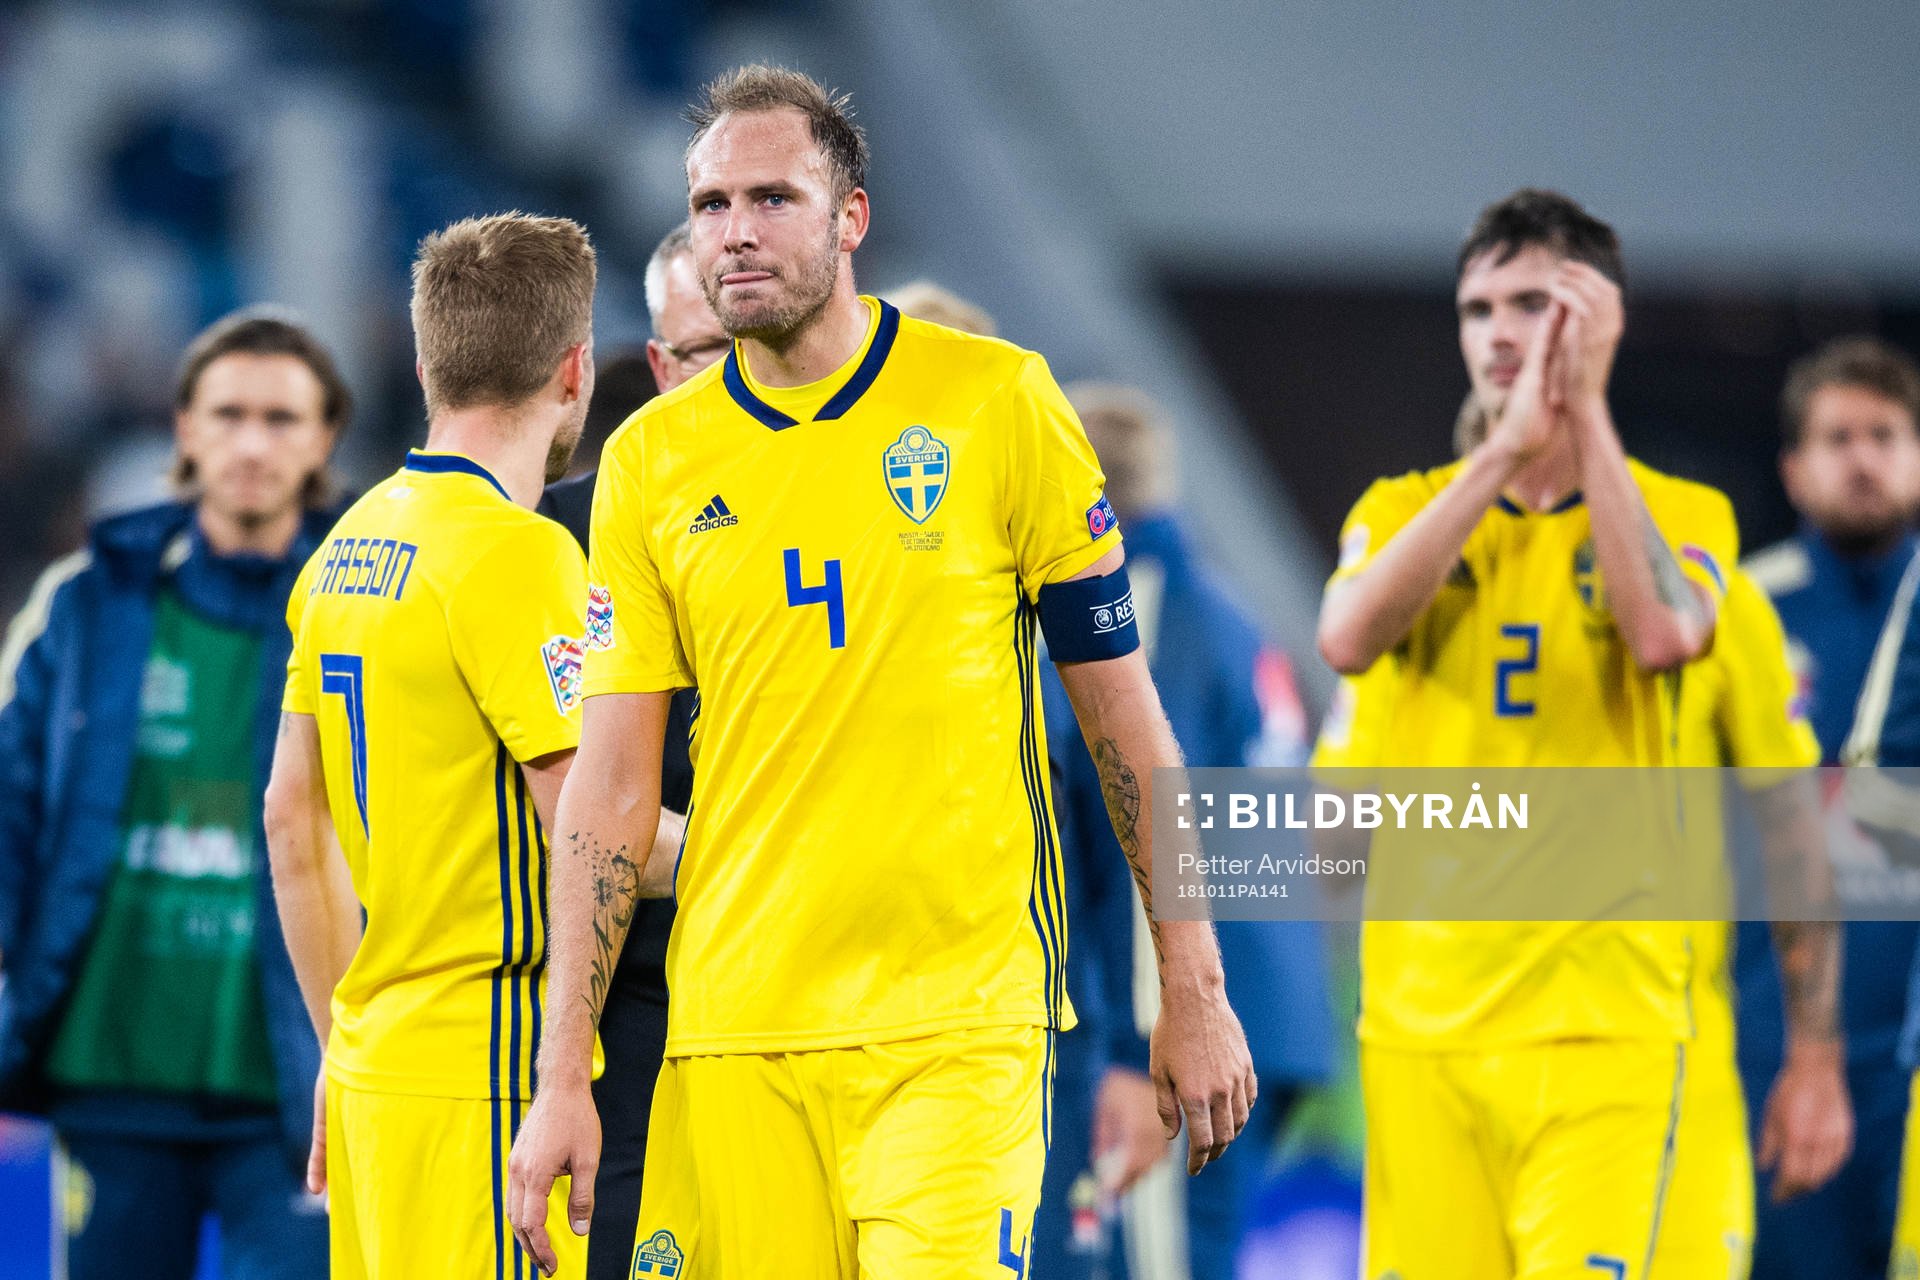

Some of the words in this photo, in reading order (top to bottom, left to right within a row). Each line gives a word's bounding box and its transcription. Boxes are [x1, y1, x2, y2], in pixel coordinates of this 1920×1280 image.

[895, 453, 938, 464] SVERIGE
[689, 514, 739, 534] adidas
[310, 538, 419, 601] ARSSON
[783, 548, 845, 649] 4
[1495, 623, 1539, 717] 2
[320, 654, 370, 842] 7
